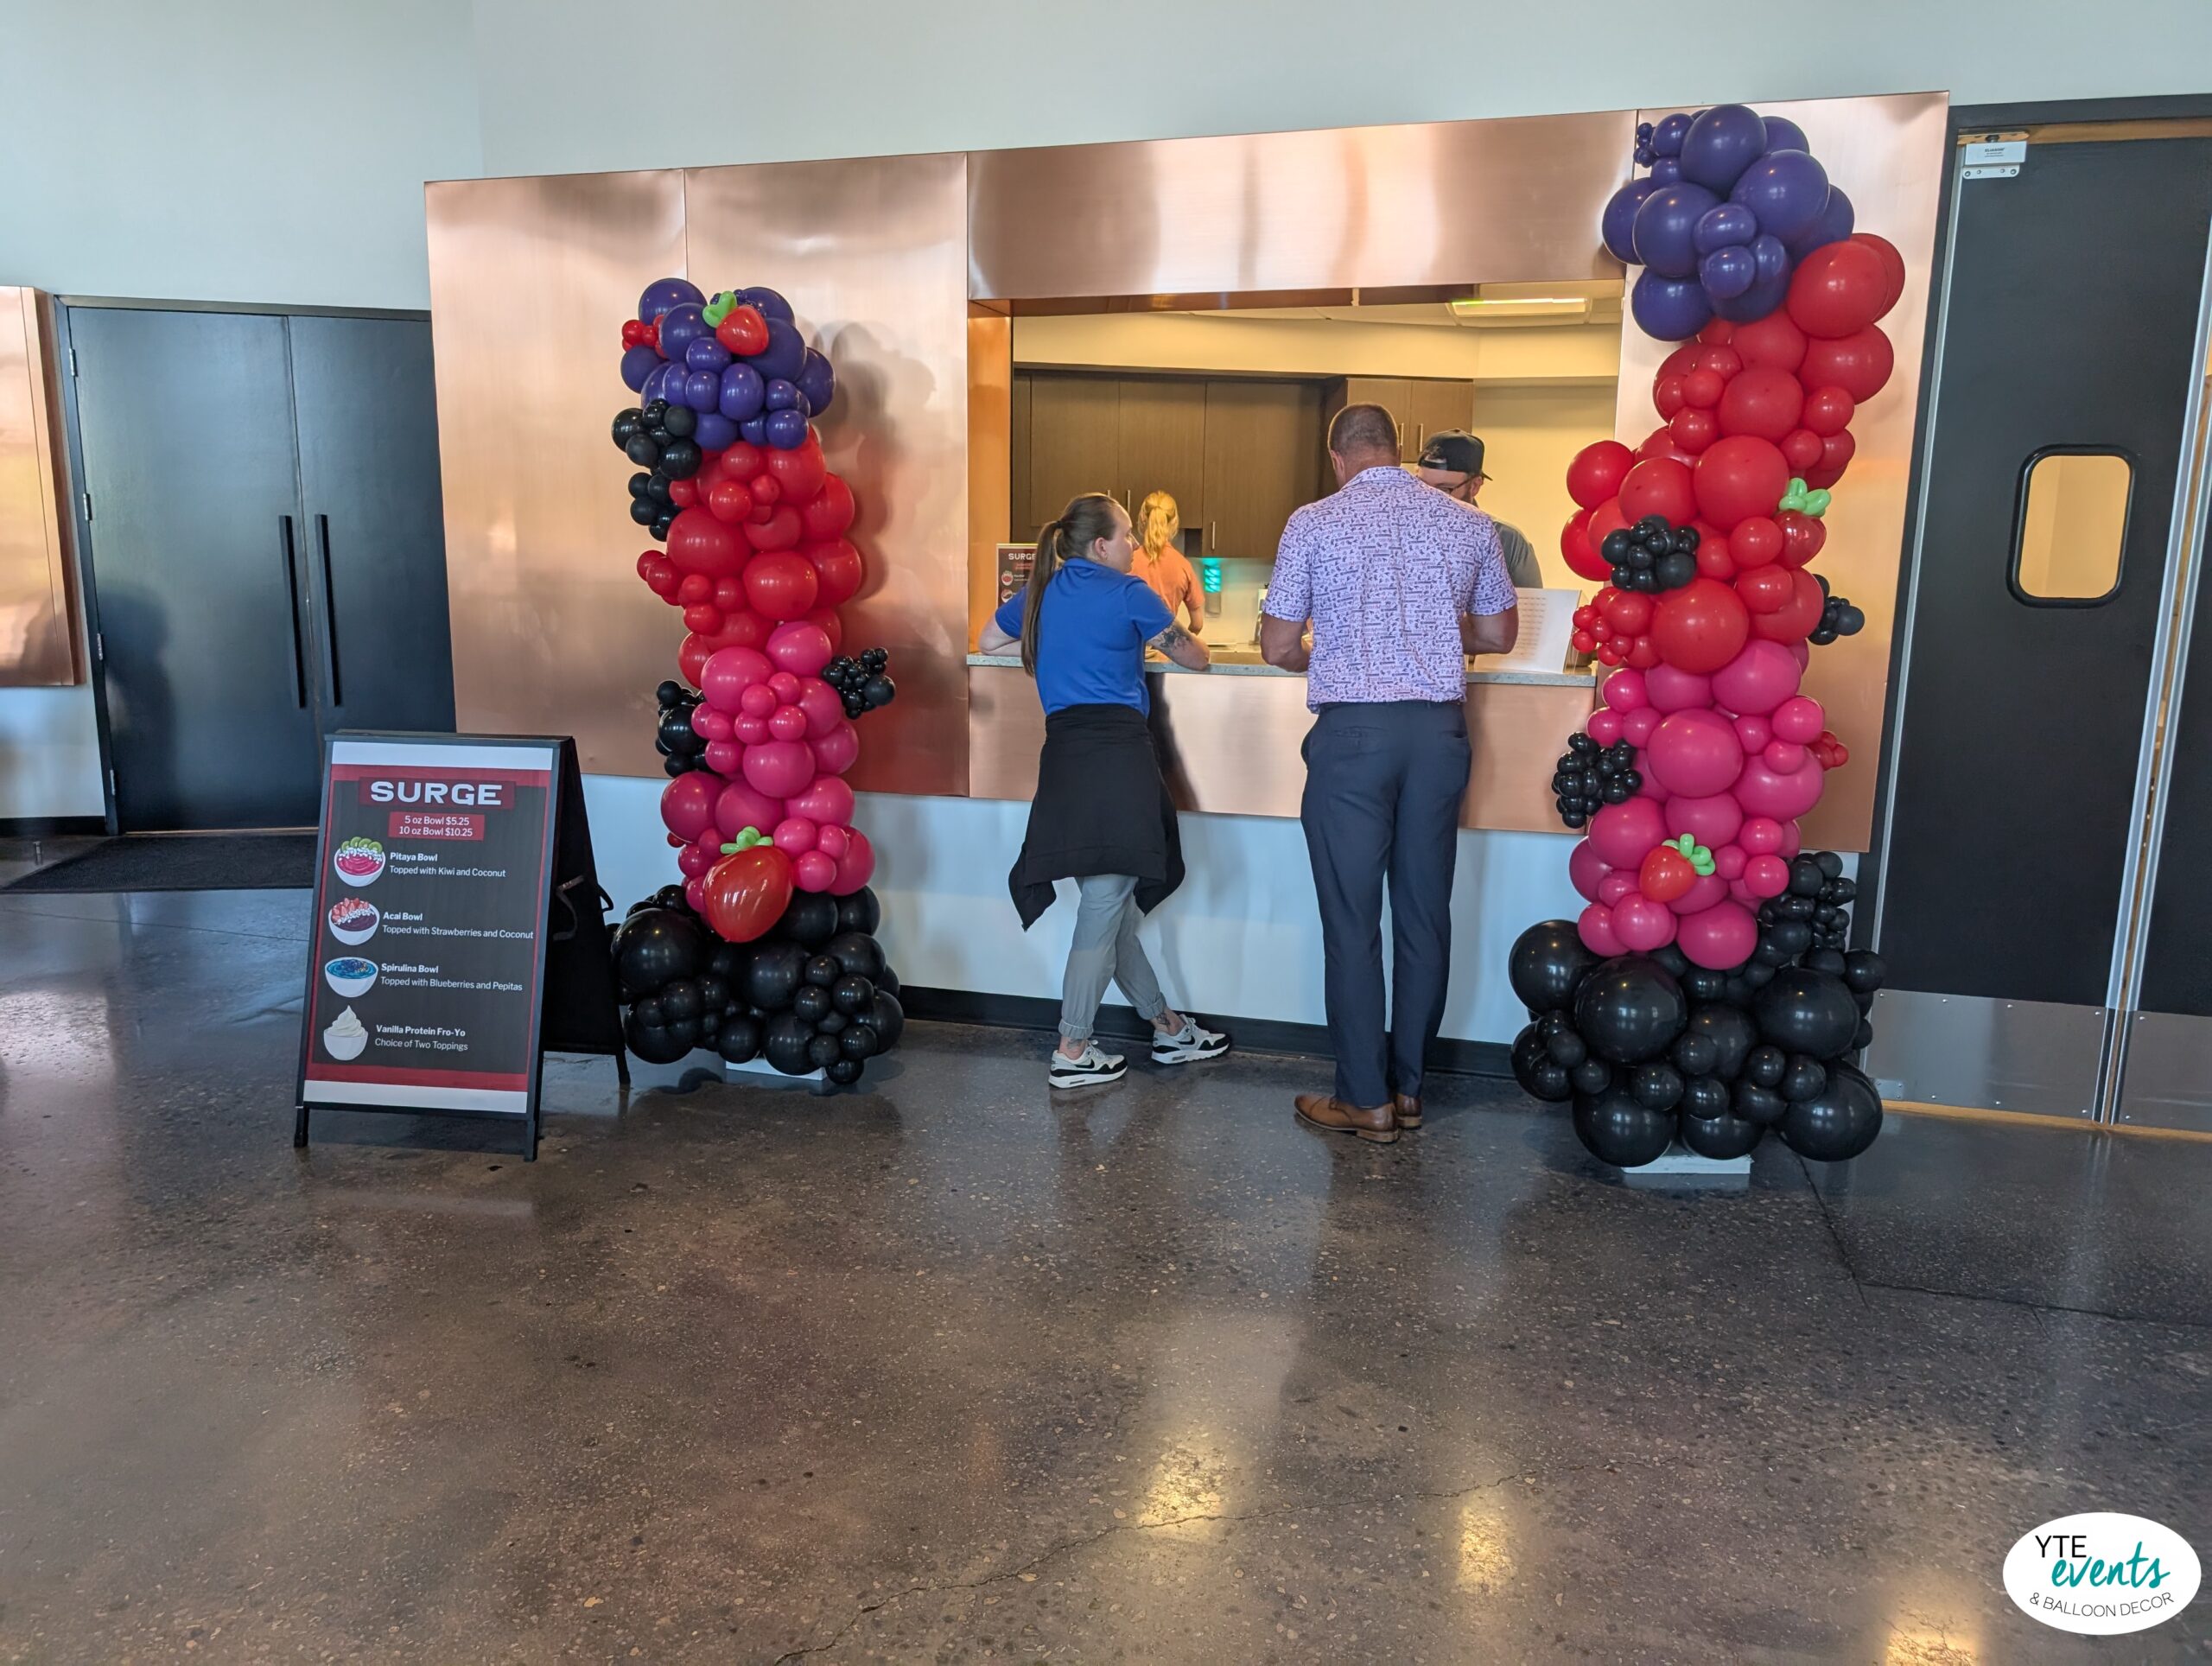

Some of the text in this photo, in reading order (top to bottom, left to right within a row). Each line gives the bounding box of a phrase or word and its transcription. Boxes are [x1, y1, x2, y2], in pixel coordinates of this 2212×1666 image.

[371, 781, 502, 805] SURGE
[404, 816, 411, 824] 5
[423, 816, 444, 825] Bowl
[445, 817, 470, 826] $5.25
[399, 826, 410, 835] 10
[423, 827, 443, 836] Bowl
[445, 828, 473, 836] $10.25
[390, 852, 438, 862] Pitaya Bowl
[390, 865, 418, 876] Topped
[419, 867, 436, 875] with
[472, 868, 506, 877] Coconut
[383, 912, 423, 921] Acai Bowl
[382, 925, 533, 939] Topped with Strawberries and Coconut
[381, 963, 439, 973] Spirulina Bowl
[380, 976, 523, 991] Topped with Blueberries and Pepitas
[376, 1024, 466, 1037] Vanilla Protein Fro-Yo
[375, 1038, 403, 1047] Choice
[415, 1040, 430, 1048] Two
[432, 1040, 468, 1052] Toppings
